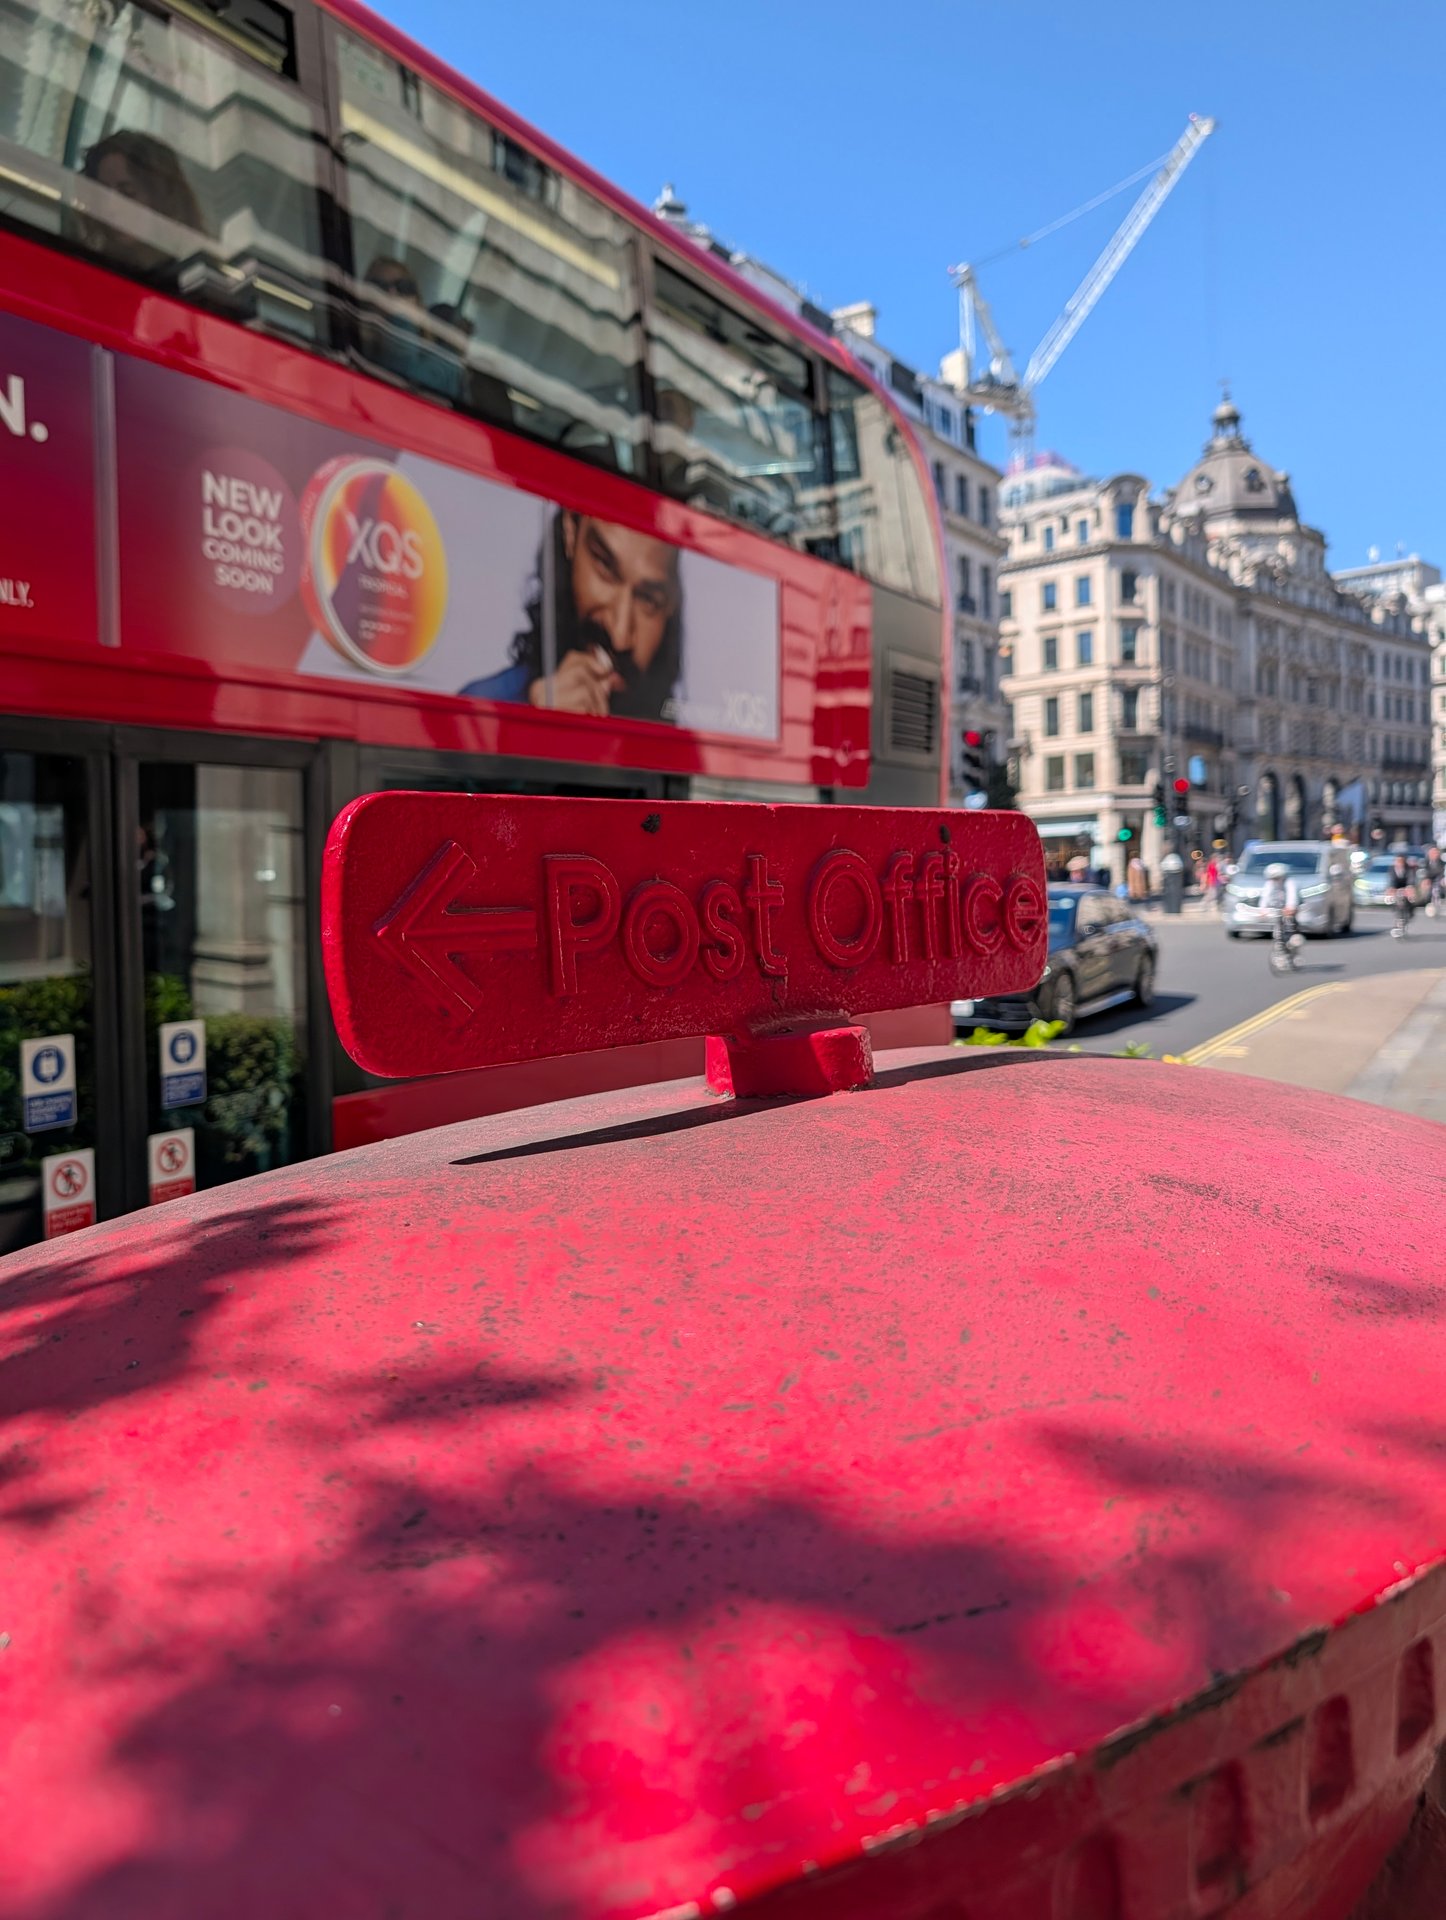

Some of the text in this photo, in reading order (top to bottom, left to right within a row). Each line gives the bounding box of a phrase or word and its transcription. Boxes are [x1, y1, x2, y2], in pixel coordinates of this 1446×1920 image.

[201, 469, 283, 520] NEW
[203, 505, 284, 553] LOOK
[346, 510, 424, 579] XQS
[202, 538, 284, 575] COMING
[214, 563, 274, 595] SOON
[542, 844, 1047, 997] Post Office
